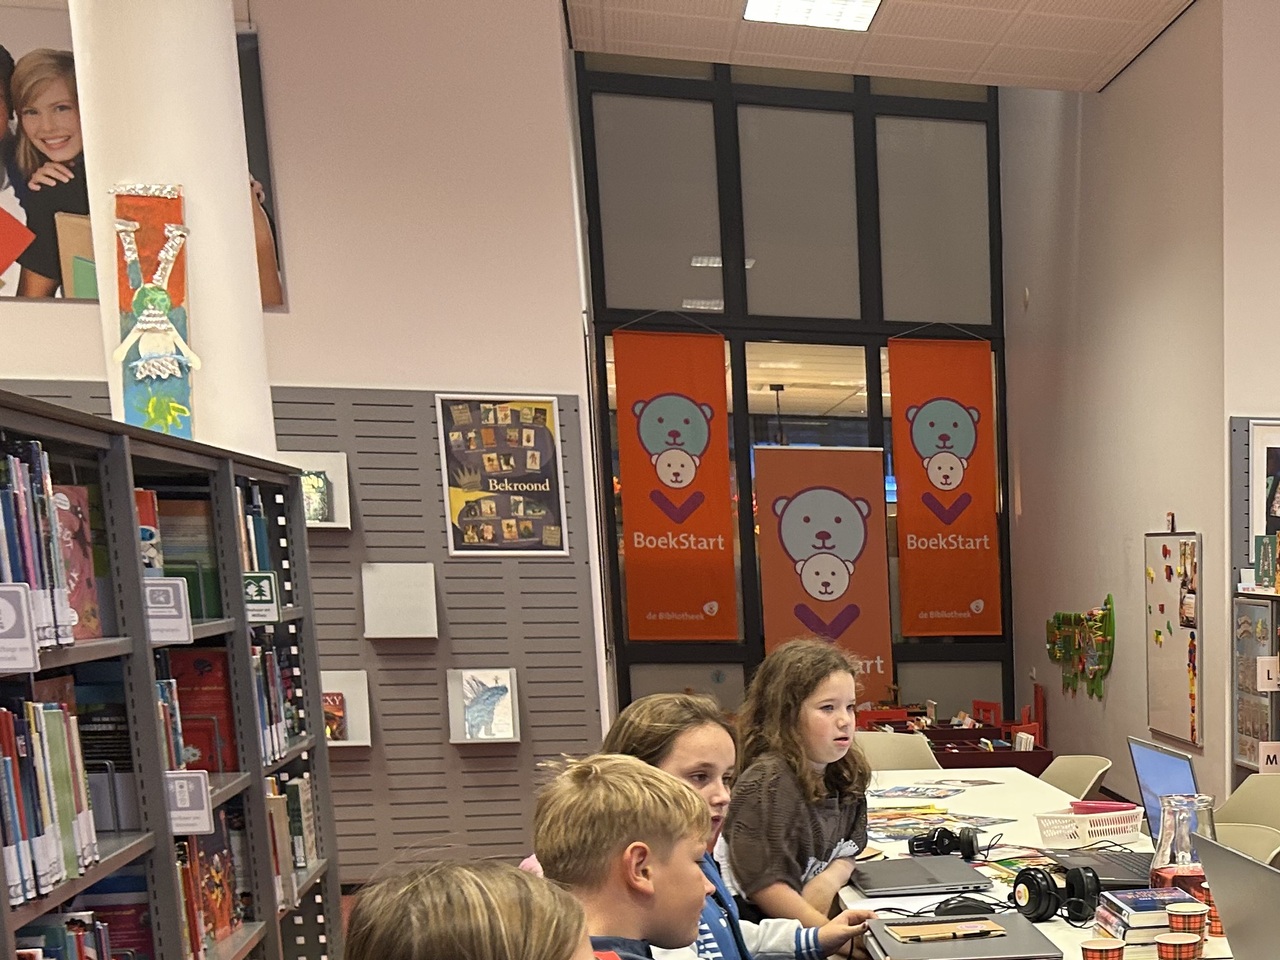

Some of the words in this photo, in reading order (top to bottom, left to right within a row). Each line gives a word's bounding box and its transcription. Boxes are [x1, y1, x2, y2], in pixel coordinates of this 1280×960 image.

[488, 479, 550, 492] Bekroond
[633, 531, 725, 550] BoekStart
[906, 533, 991, 550] BoekStart
[658, 612, 705, 620] Bibliotheek
[919, 611, 928, 619] de
[929, 611, 971, 619] Bibliotheek
[1266, 669, 1273, 681] L
[1265, 754, 1278, 765] M
